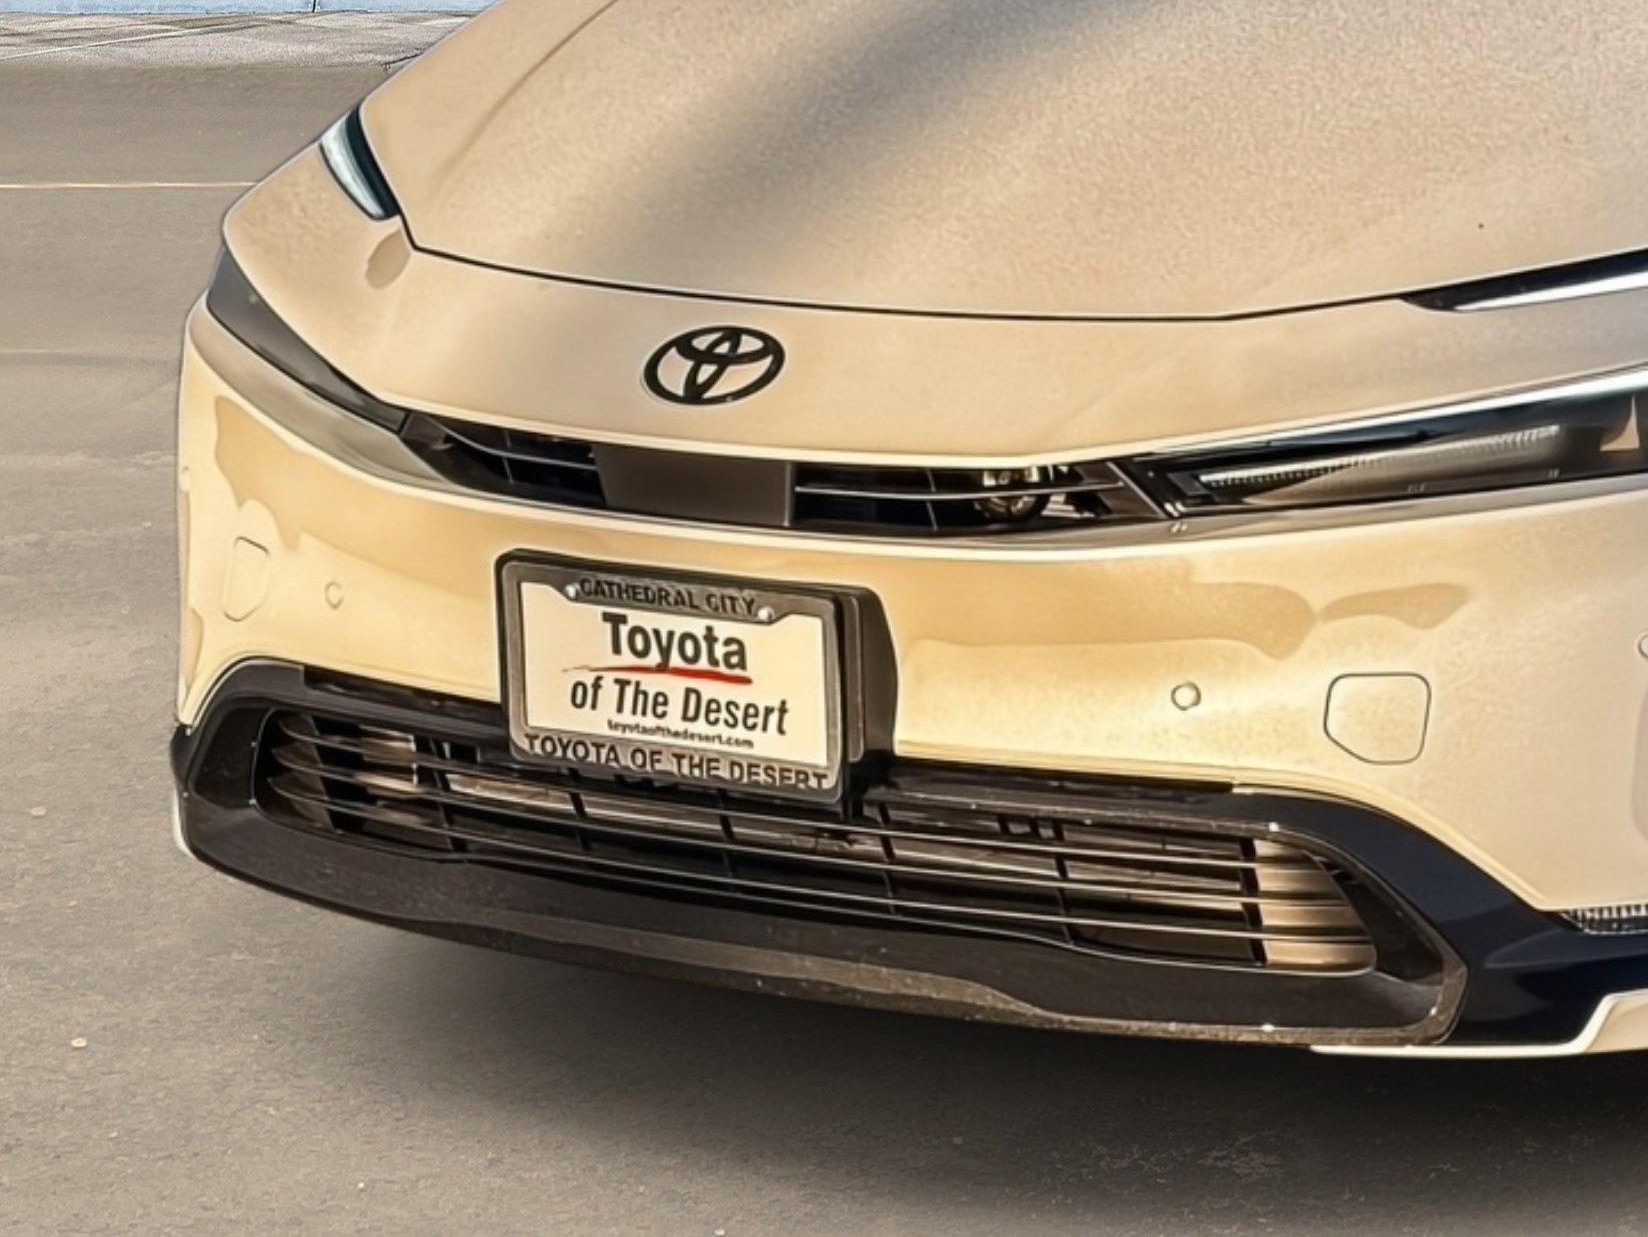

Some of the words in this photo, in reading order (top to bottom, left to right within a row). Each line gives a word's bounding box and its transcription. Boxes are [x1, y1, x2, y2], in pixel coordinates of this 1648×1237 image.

[579, 578, 700, 609] CATHEDRAL
[705, 592, 756, 616] CITY
[602, 613, 747, 671] Toyota
[570, 675, 603, 711] of
[614, 677, 669, 719] The
[682, 686, 789, 735] Desert
[525, 733, 621, 767] TOYOTA
[630, 748, 662, 771] OF
[672, 754, 721, 779] THE
[729, 762, 828, 790] DESERT
